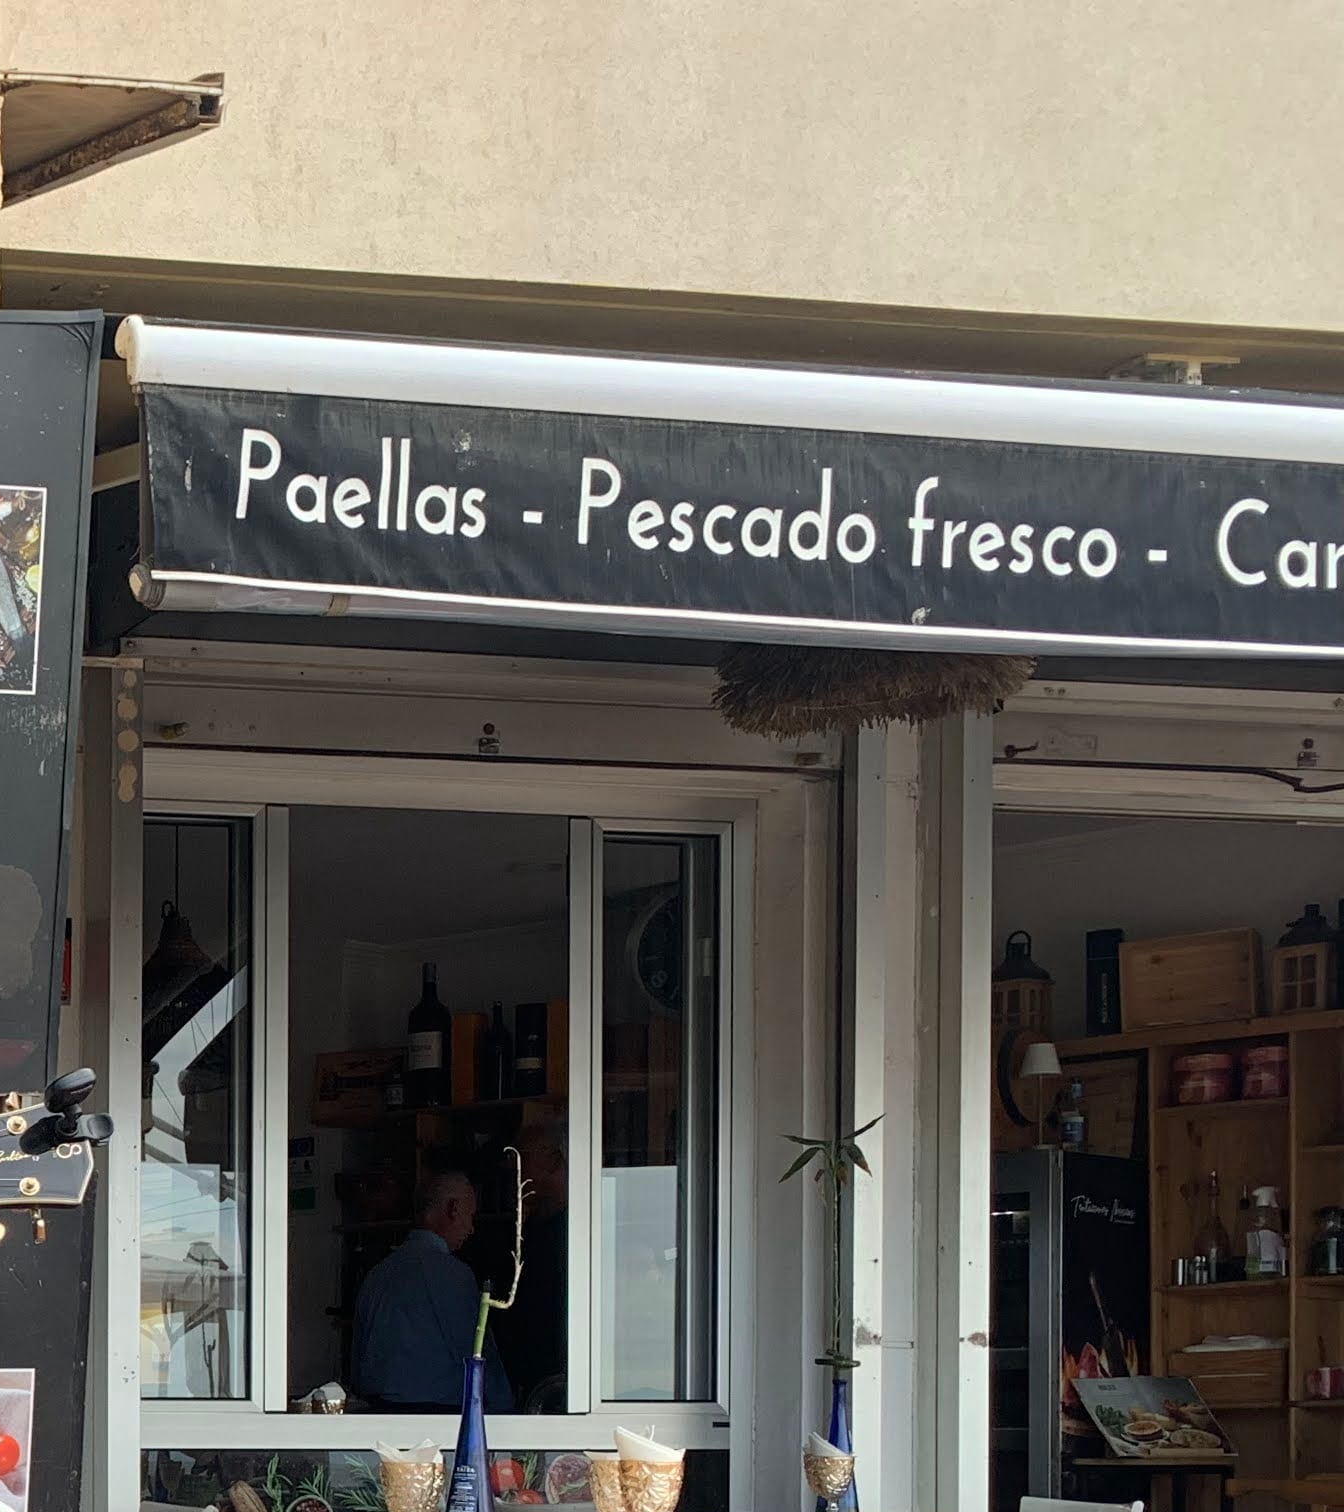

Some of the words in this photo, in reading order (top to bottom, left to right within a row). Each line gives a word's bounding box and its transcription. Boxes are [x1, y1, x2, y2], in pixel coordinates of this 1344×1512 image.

[235, 428, 487, 538] Paellas
[577, 456, 877, 564] Pescado
[908, 476, 1118, 578] fresco
